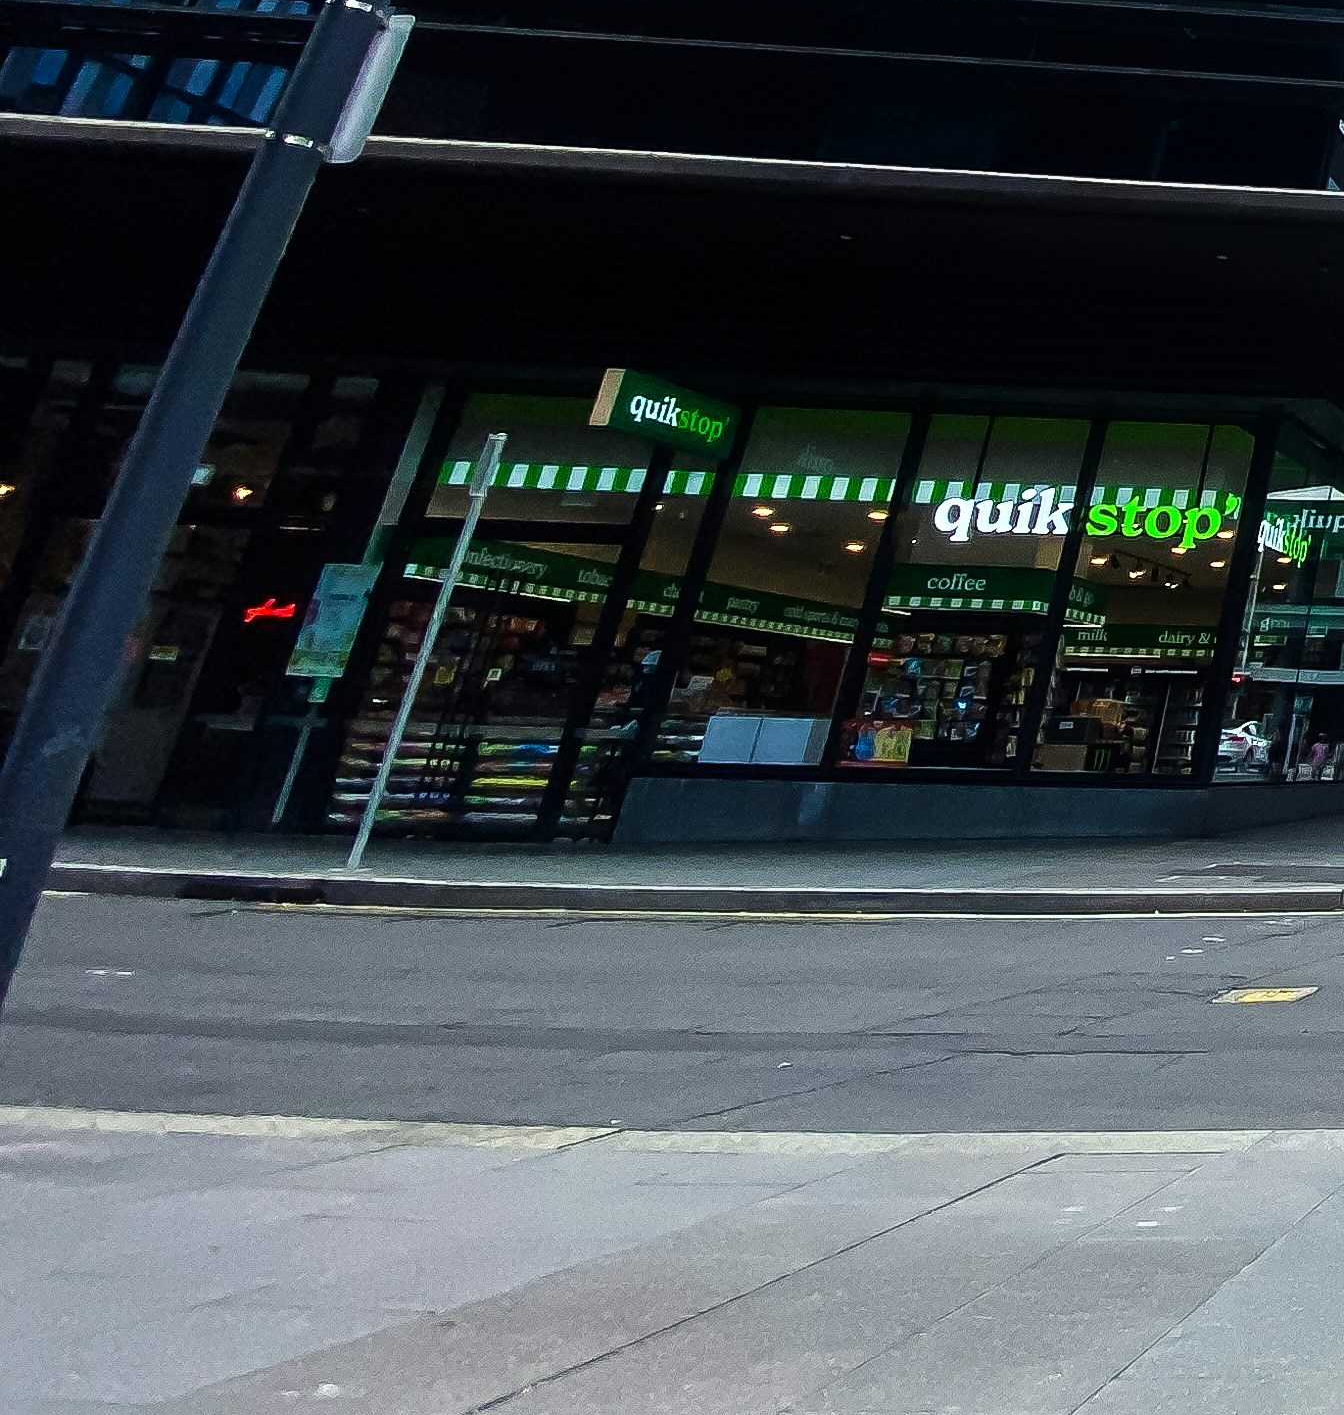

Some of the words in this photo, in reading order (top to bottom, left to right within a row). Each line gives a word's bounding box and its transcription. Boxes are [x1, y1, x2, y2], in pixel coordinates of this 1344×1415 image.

[927, 573, 987, 591] coffee
[1077, 629, 1108, 642] milk
[1158, 630, 1195, 645] dairy
[1197, 632, 1211, 645] &
